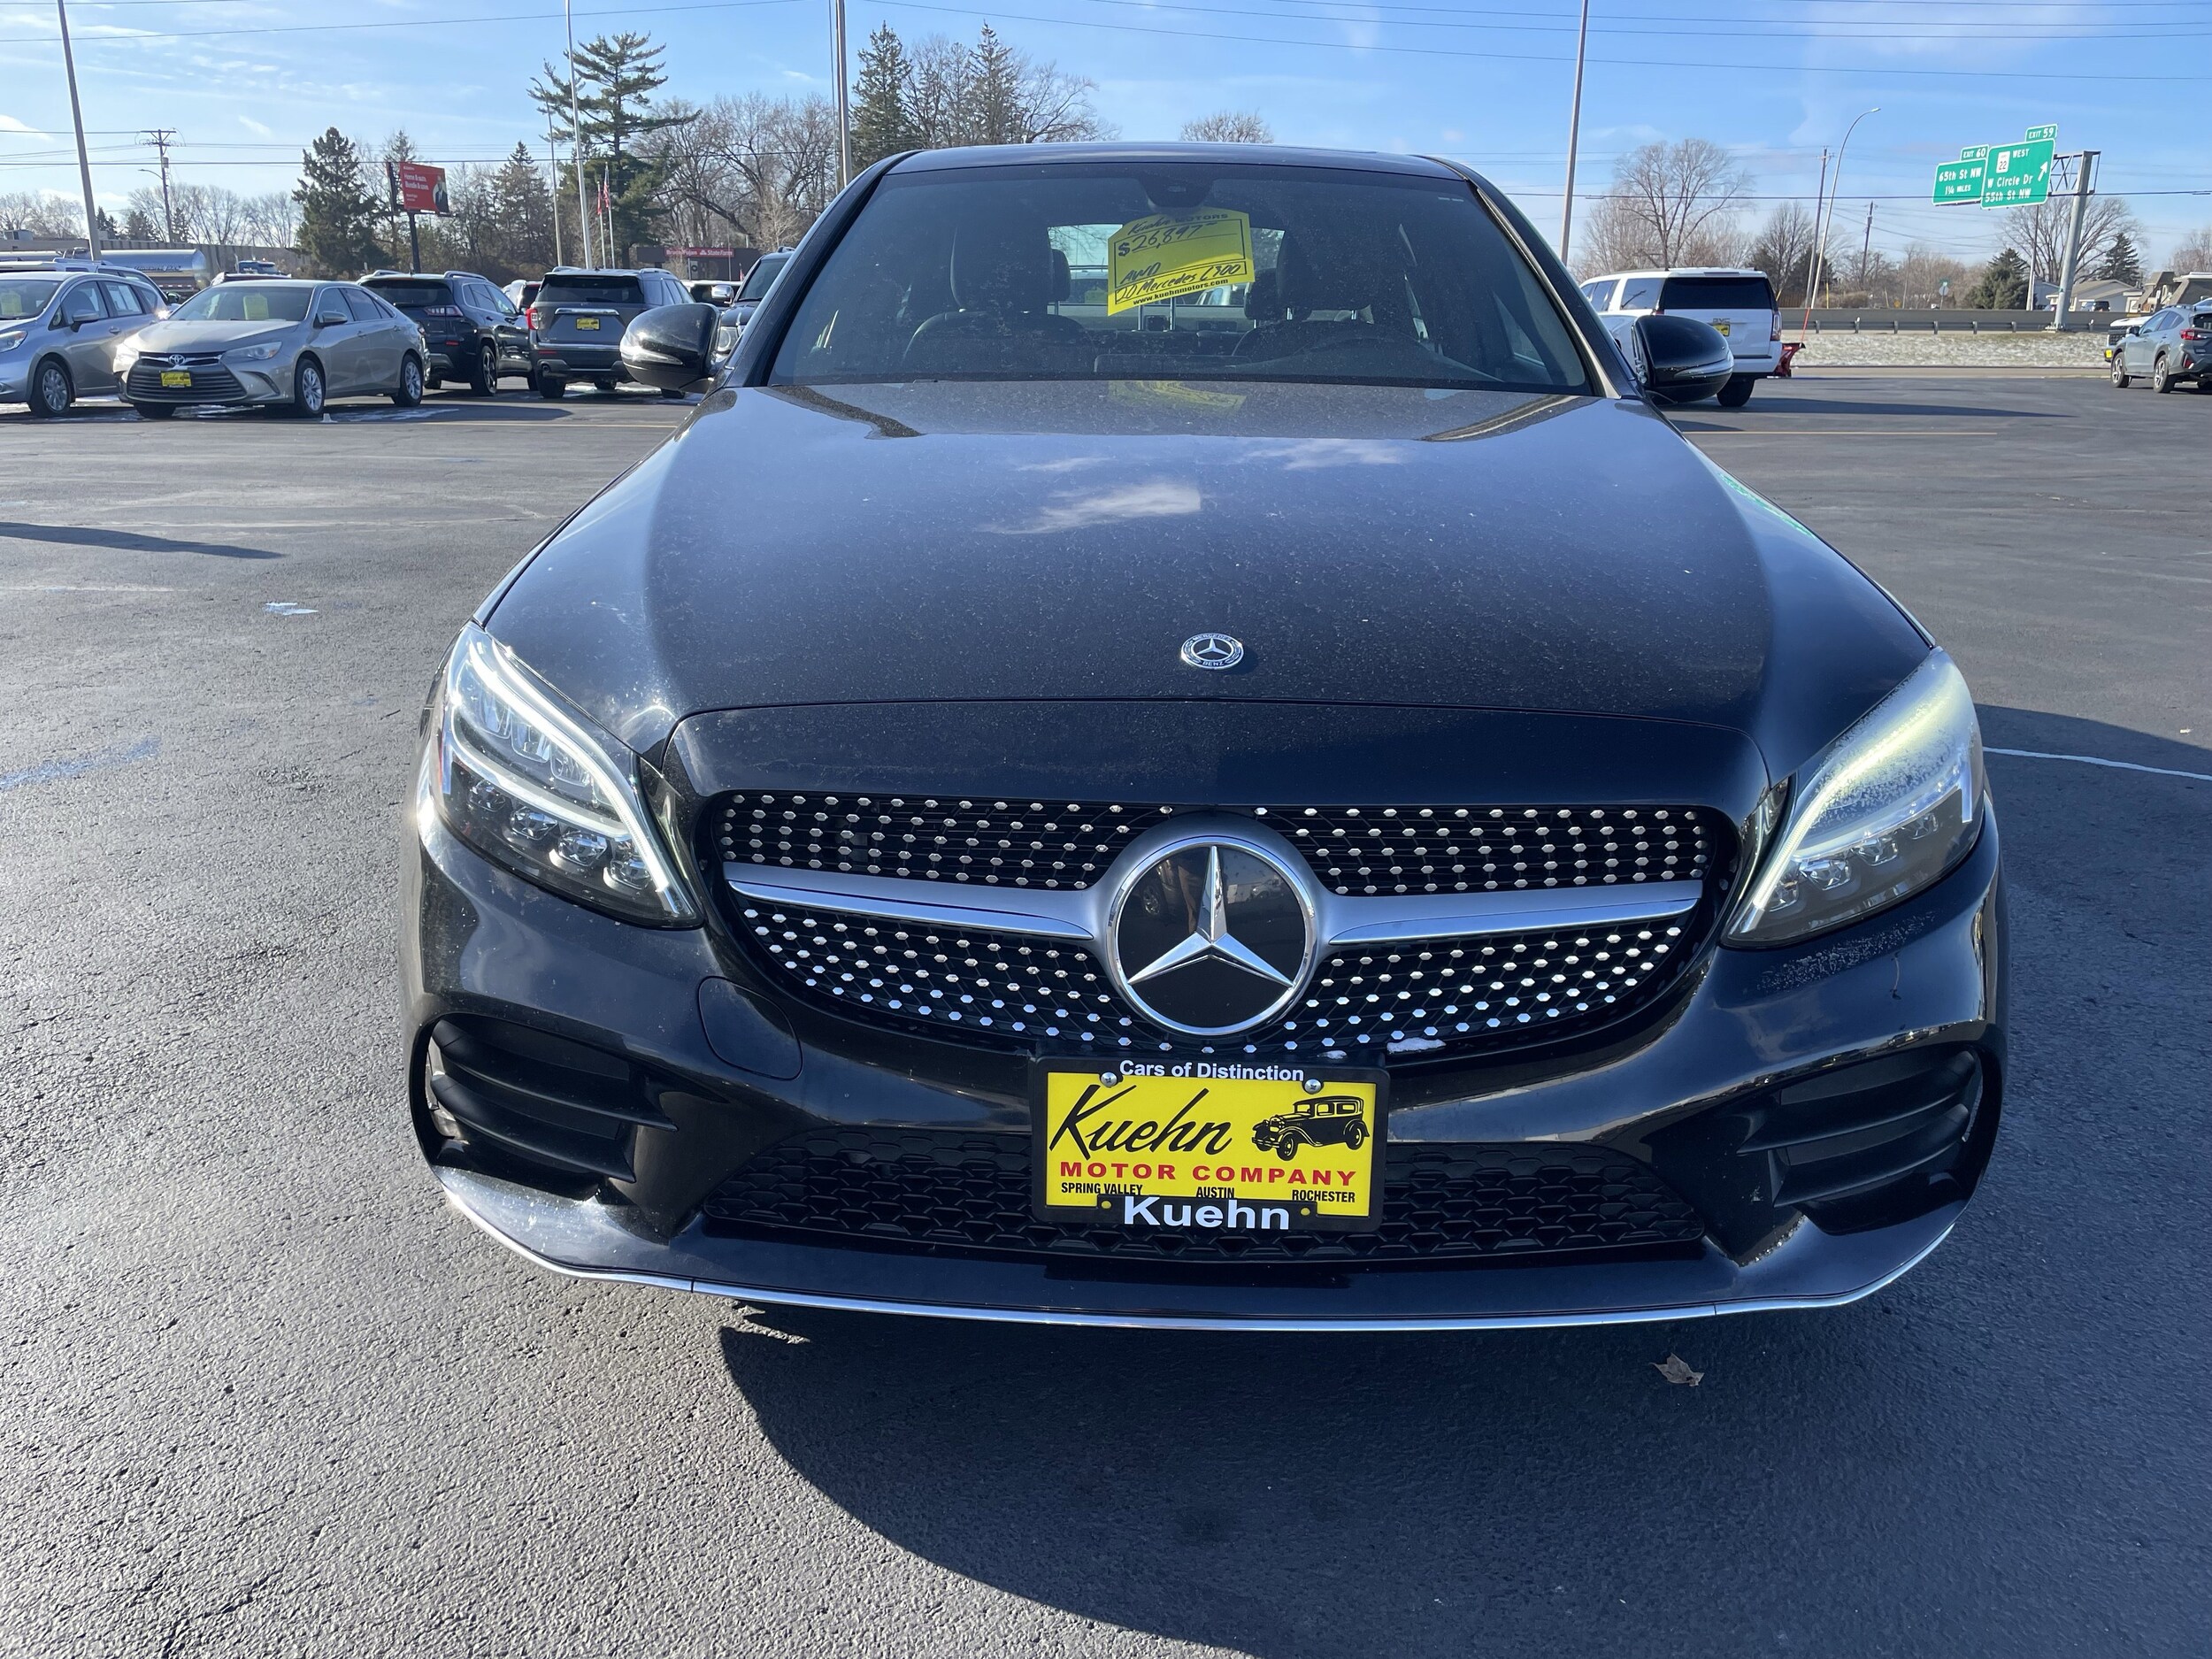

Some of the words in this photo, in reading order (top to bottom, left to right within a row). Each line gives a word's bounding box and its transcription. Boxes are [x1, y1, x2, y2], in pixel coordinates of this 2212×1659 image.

[2028, 130, 2041, 139] EXIT
[2043, 127, 2054, 138] 59
[1976, 147, 1986, 157] 60
[2012, 149, 2030, 158] WEST
[1998, 160, 2008, 170] 22
[1939, 170, 1956, 182] 65th
[1959, 169, 1968, 180] St
[1970, 166, 1982, 178] NW
[1987, 178, 1994, 188] W
[1996, 176, 2020, 188] Circle
[2024, 173, 2033, 185] Dr
[1985, 191, 2003, 203] 55th
[2007, 189, 2016, 201] St
[2018, 188, 2032, 199] NW
[1127, 217, 1168, 235] Kuehn
[1175, 213, 1228, 223] MOTORS
[1120, 261, 1161, 284] AWD
[1133, 278, 1229, 305] www.kuehnmotors.com
[1136, 273, 1196, 296] Mercedes
[1118, 1060, 1165, 1077] Cars
[1171, 1061, 1192, 1079] of
[1196, 1062, 1304, 1081] Distinction
[1048, 1084, 1233, 1161] Kuehn
[1060, 1161, 1176, 1180] MOTOR
[1192, 1165, 1356, 1187] COMPANY
[1061, 1181, 1102, 1194] SPRING
[1102, 1183, 1143, 1196] VALLEY
[1195, 1186, 1235, 1199] AUSTIN
[1292, 1189, 1356, 1203] ROCHESTER
[1124, 1194, 1290, 1230] Kuehn
